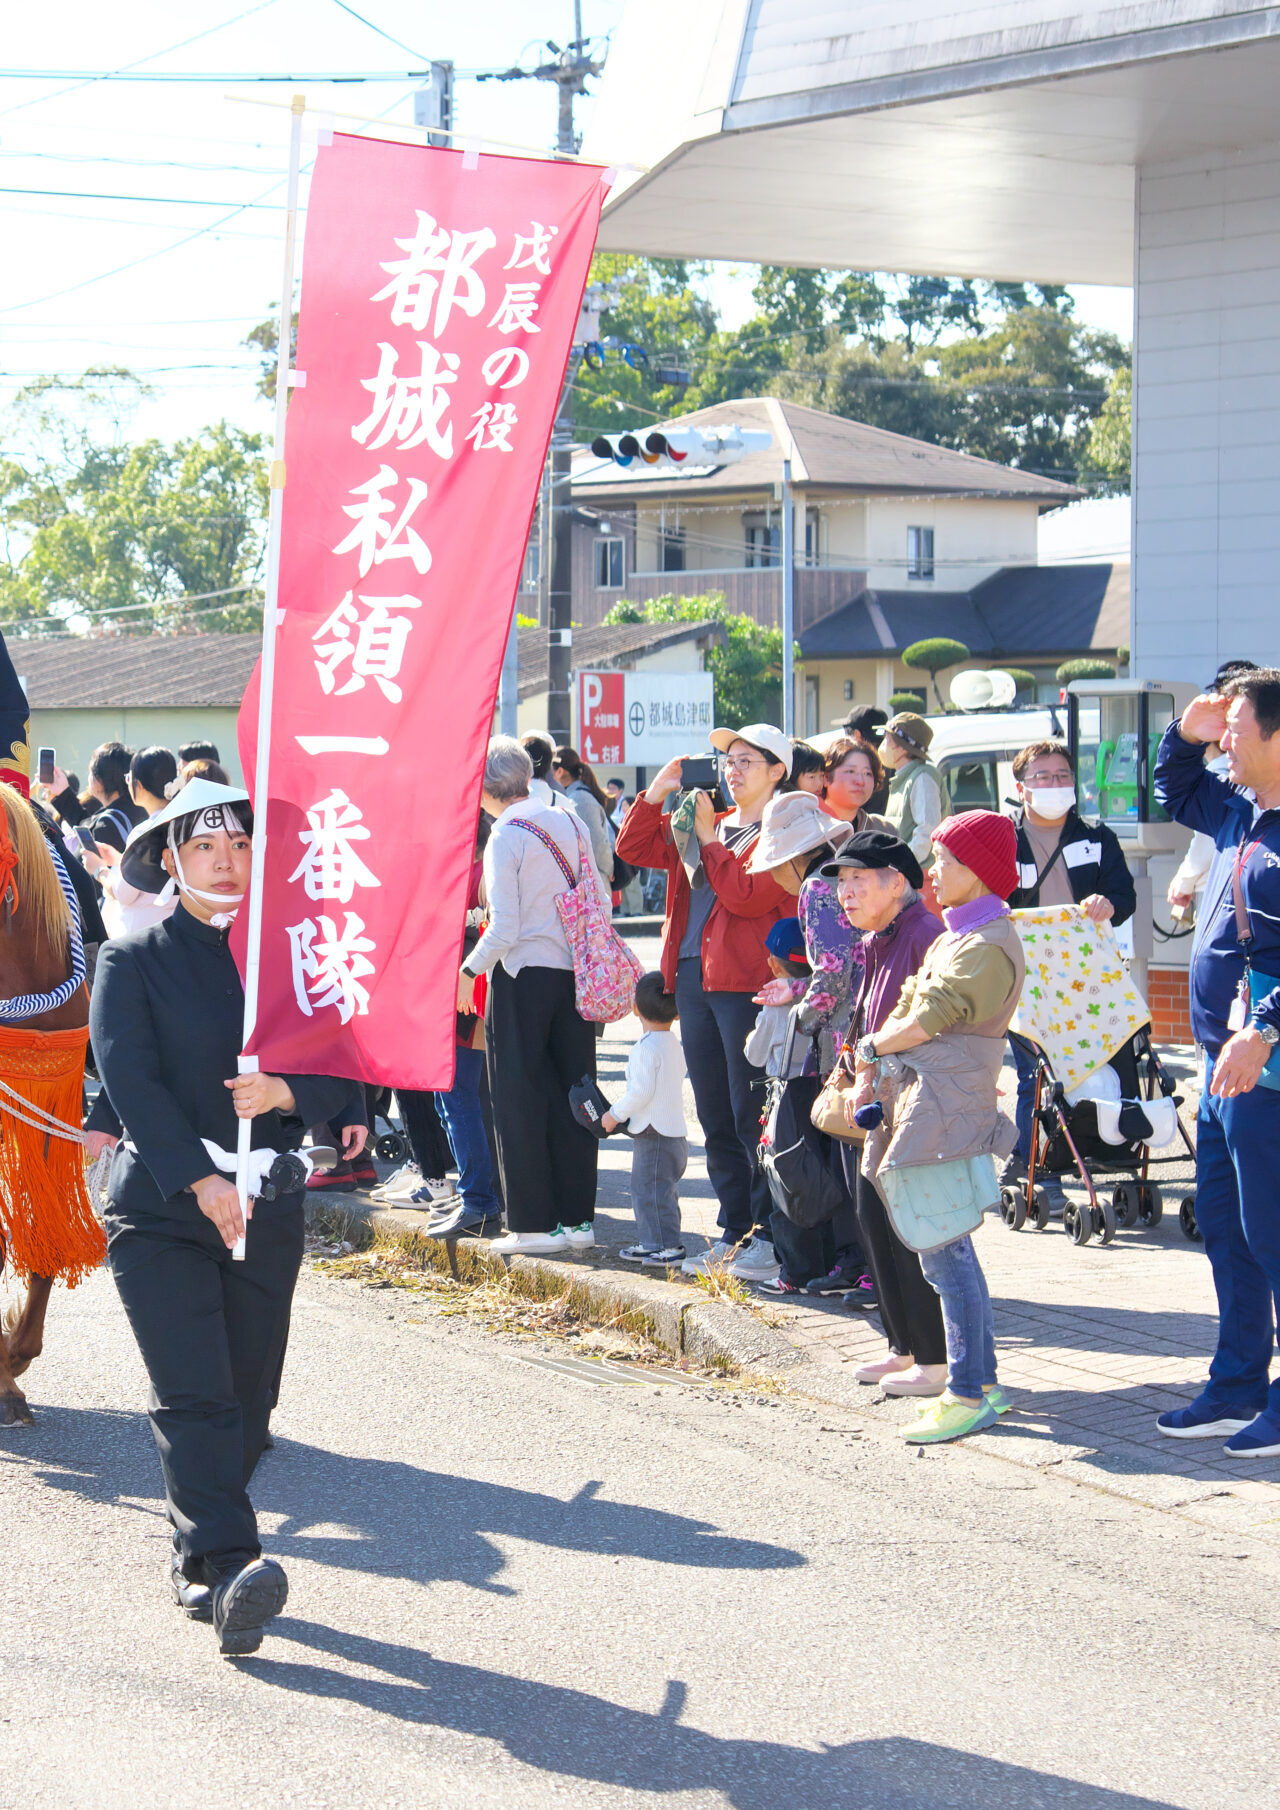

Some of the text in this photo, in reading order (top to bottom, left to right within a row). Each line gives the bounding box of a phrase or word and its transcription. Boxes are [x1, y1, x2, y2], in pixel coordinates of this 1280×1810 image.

[465, 220, 558, 452] 戊辰の役
[284, 209, 496, 1025] 都城私領一番隊
[583, 674, 603, 727] P
[649, 701, 711, 728] 都城島津邸
